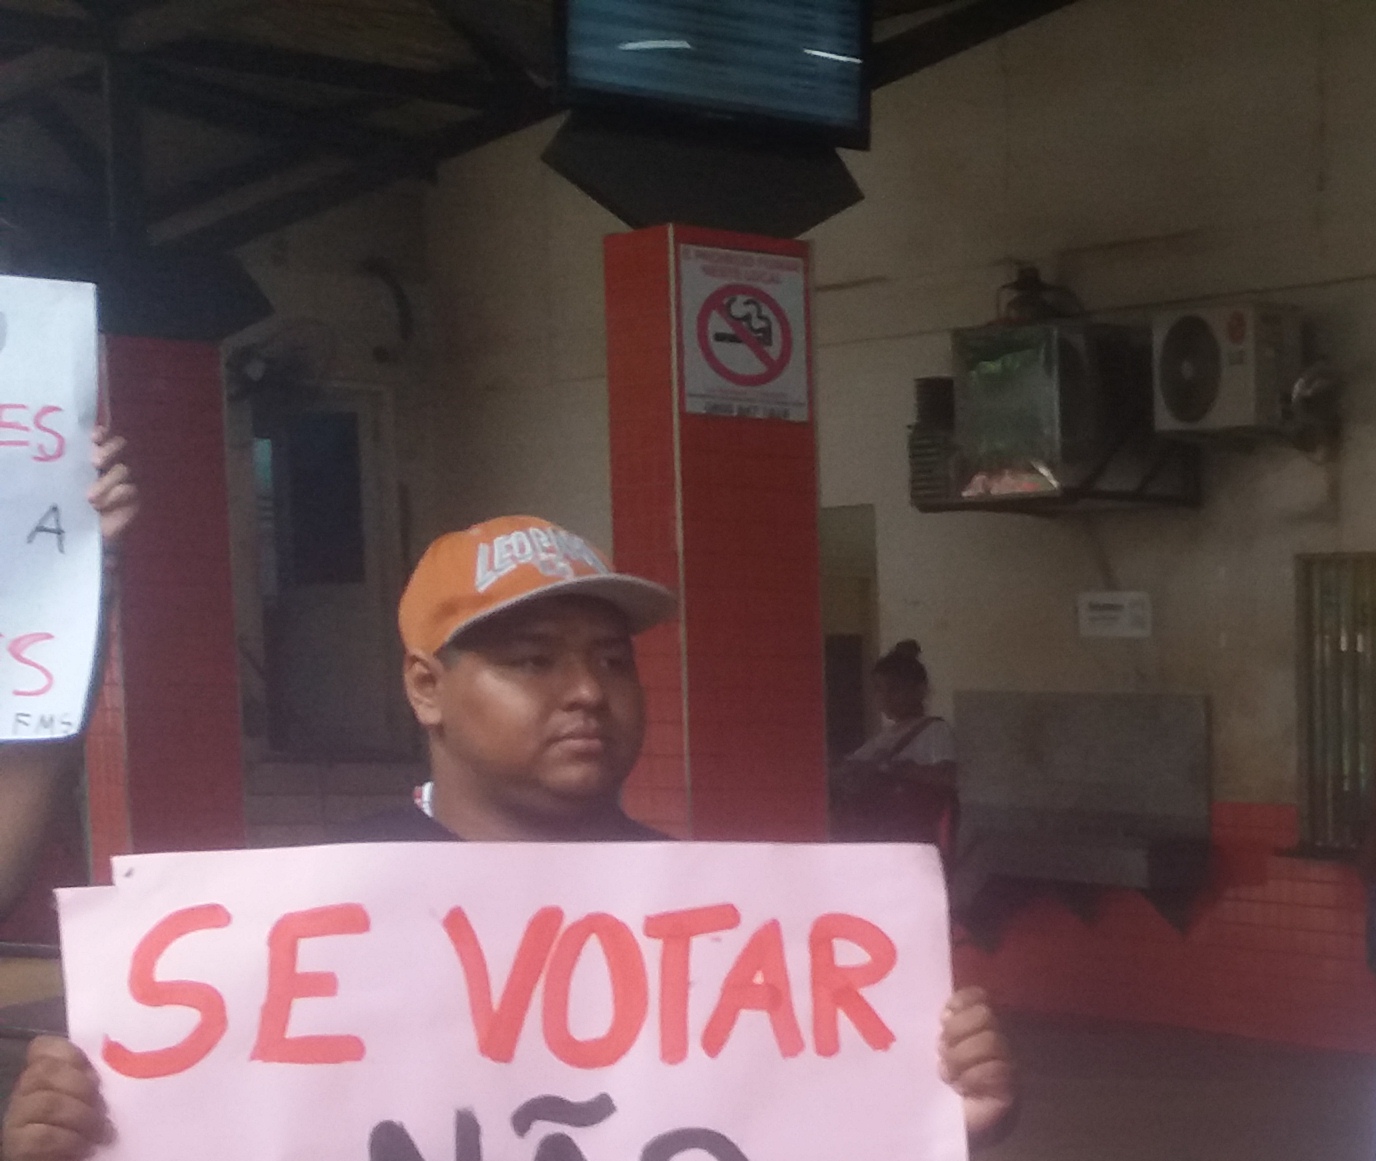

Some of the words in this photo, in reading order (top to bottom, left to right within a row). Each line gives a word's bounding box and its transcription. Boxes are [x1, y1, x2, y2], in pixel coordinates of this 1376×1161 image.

[27, 504, 64, 553] A
[101, 903, 370, 1078] SE
[442, 904, 897, 1069] VOTAR
